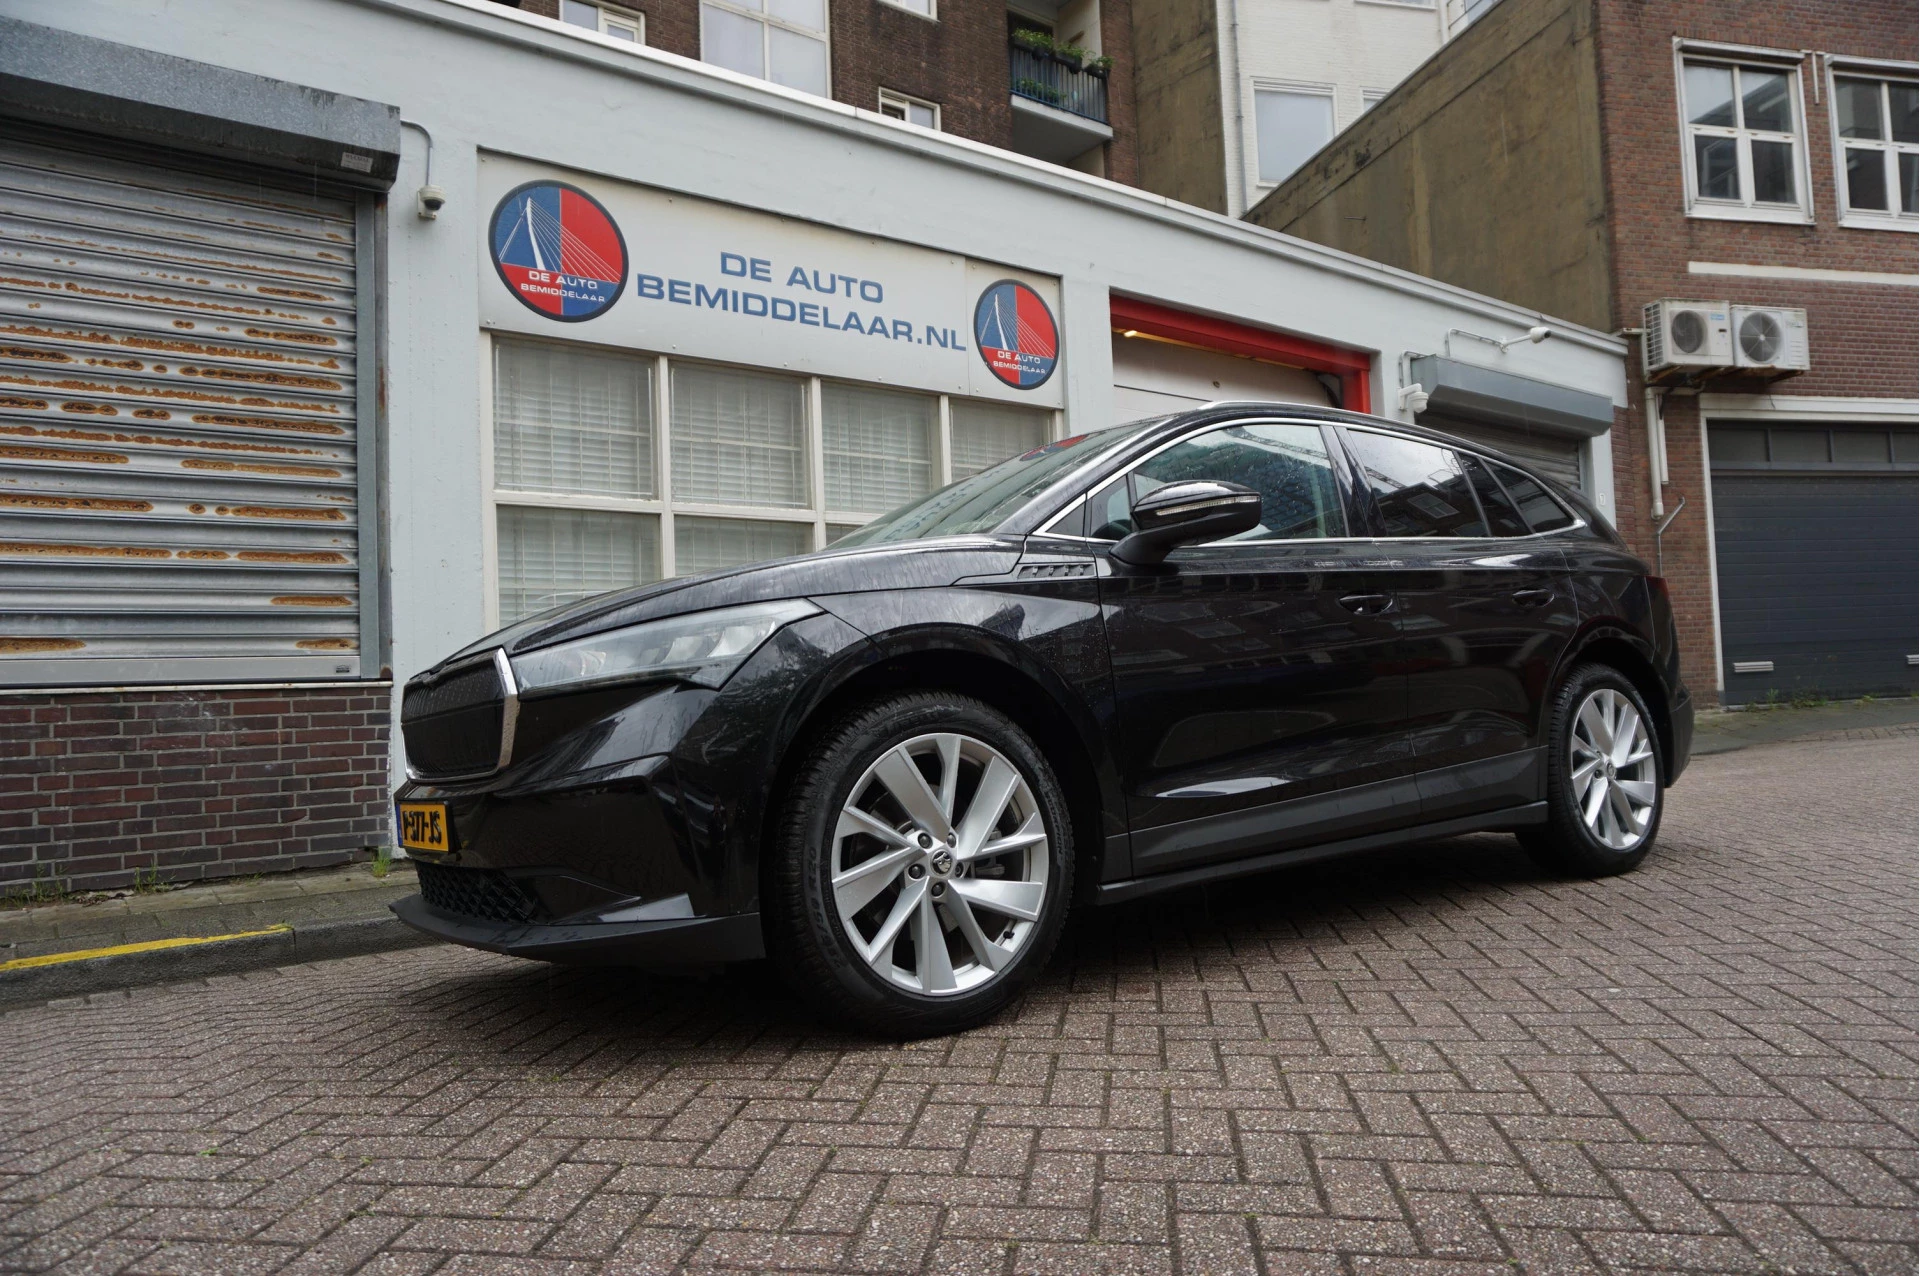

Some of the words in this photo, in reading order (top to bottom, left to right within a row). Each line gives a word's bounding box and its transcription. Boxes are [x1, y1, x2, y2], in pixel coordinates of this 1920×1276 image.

[528, 270, 551, 282] DE
[555, 275, 598, 289] AUTO
[720, 251, 772, 282] DE
[786, 266, 884, 304] AUTO
[520, 283, 605, 302] BEMIDDELAAR
[637, 273, 967, 351] BEMIDDELAAR.NL
[997, 350, 1012, 360] DE
[1014, 353, 1041, 364] AUTO
[993, 360, 1046, 374] BEMIDDELAAR
